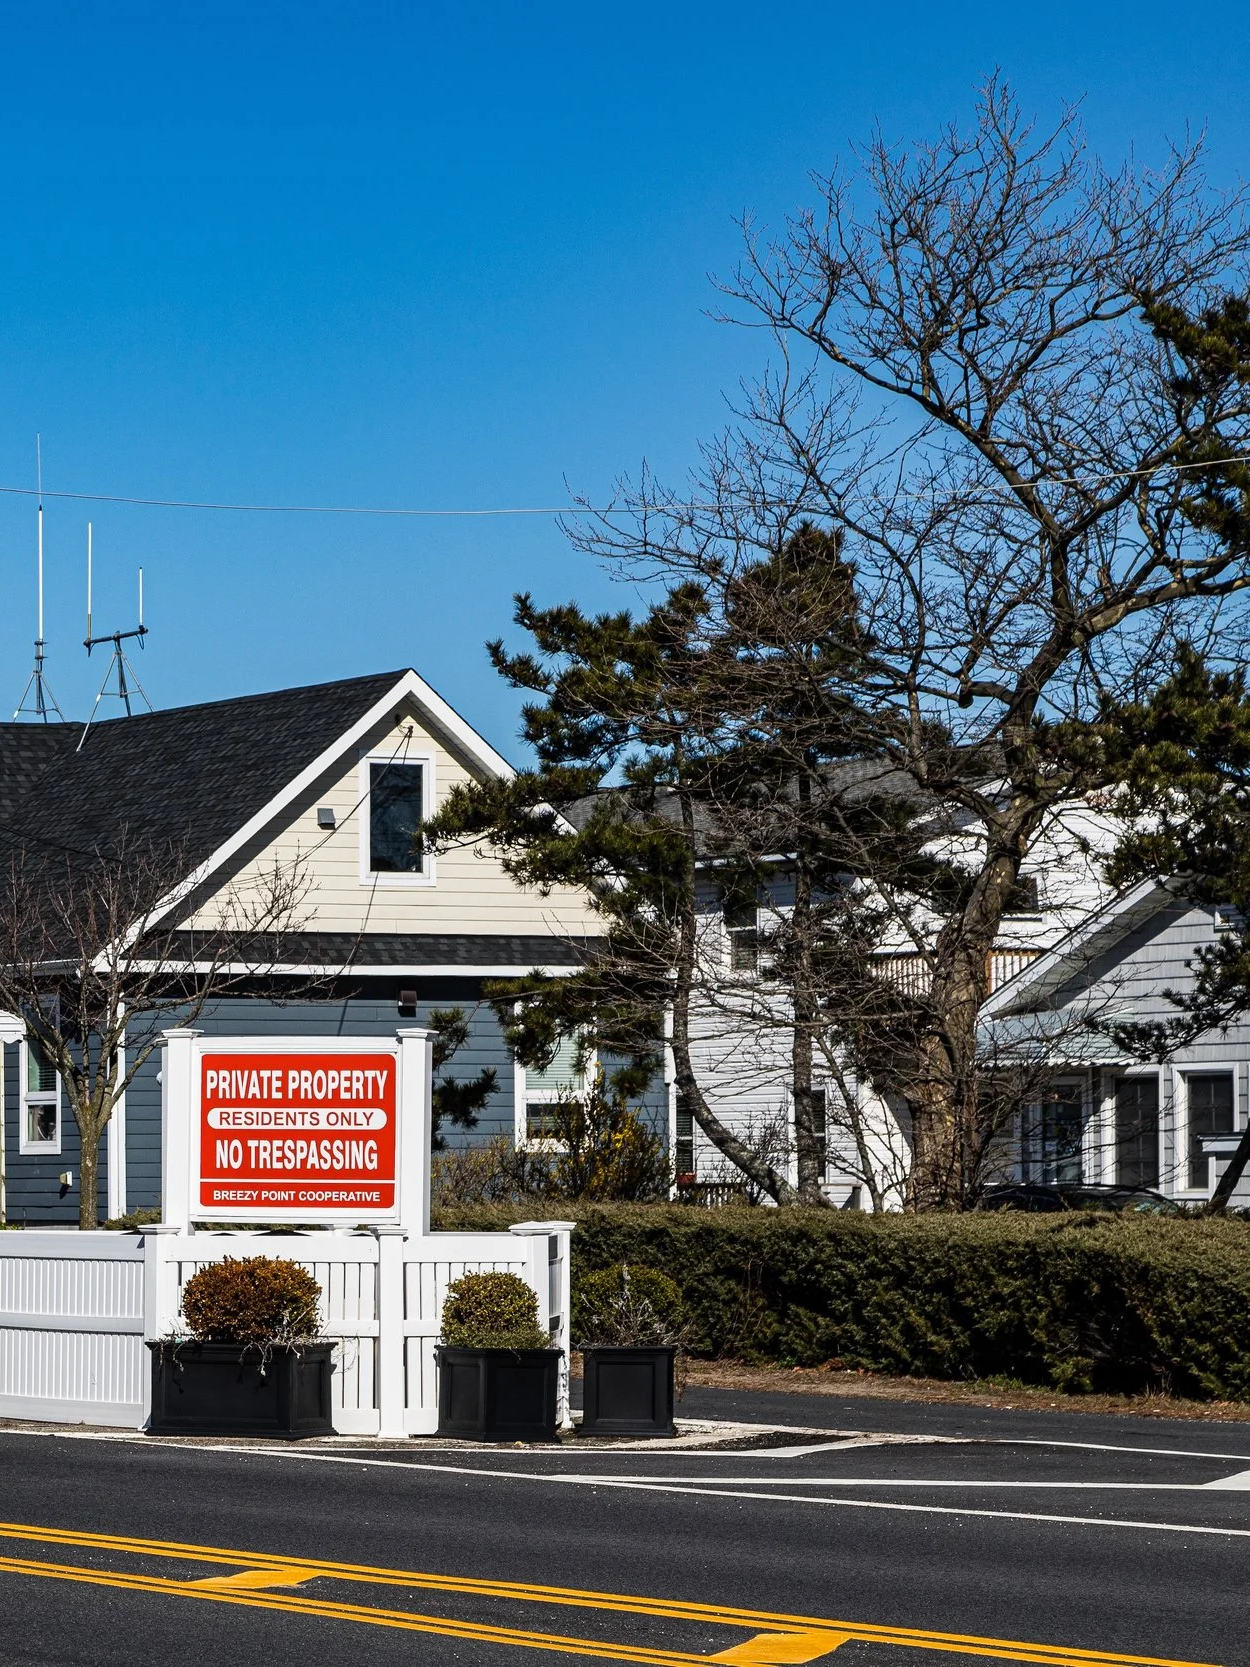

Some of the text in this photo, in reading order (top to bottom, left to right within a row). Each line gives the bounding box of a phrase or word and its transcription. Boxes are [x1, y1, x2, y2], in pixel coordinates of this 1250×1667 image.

[206, 1069, 388, 1100] PRIVATE PROPERTY
[219, 1111, 374, 1126] RESIDENTS ONLY
[215, 1139, 378, 1170] NO TRESPASSING
[213, 1190, 380, 1202] BREEZY POINT COOPERATIVE
